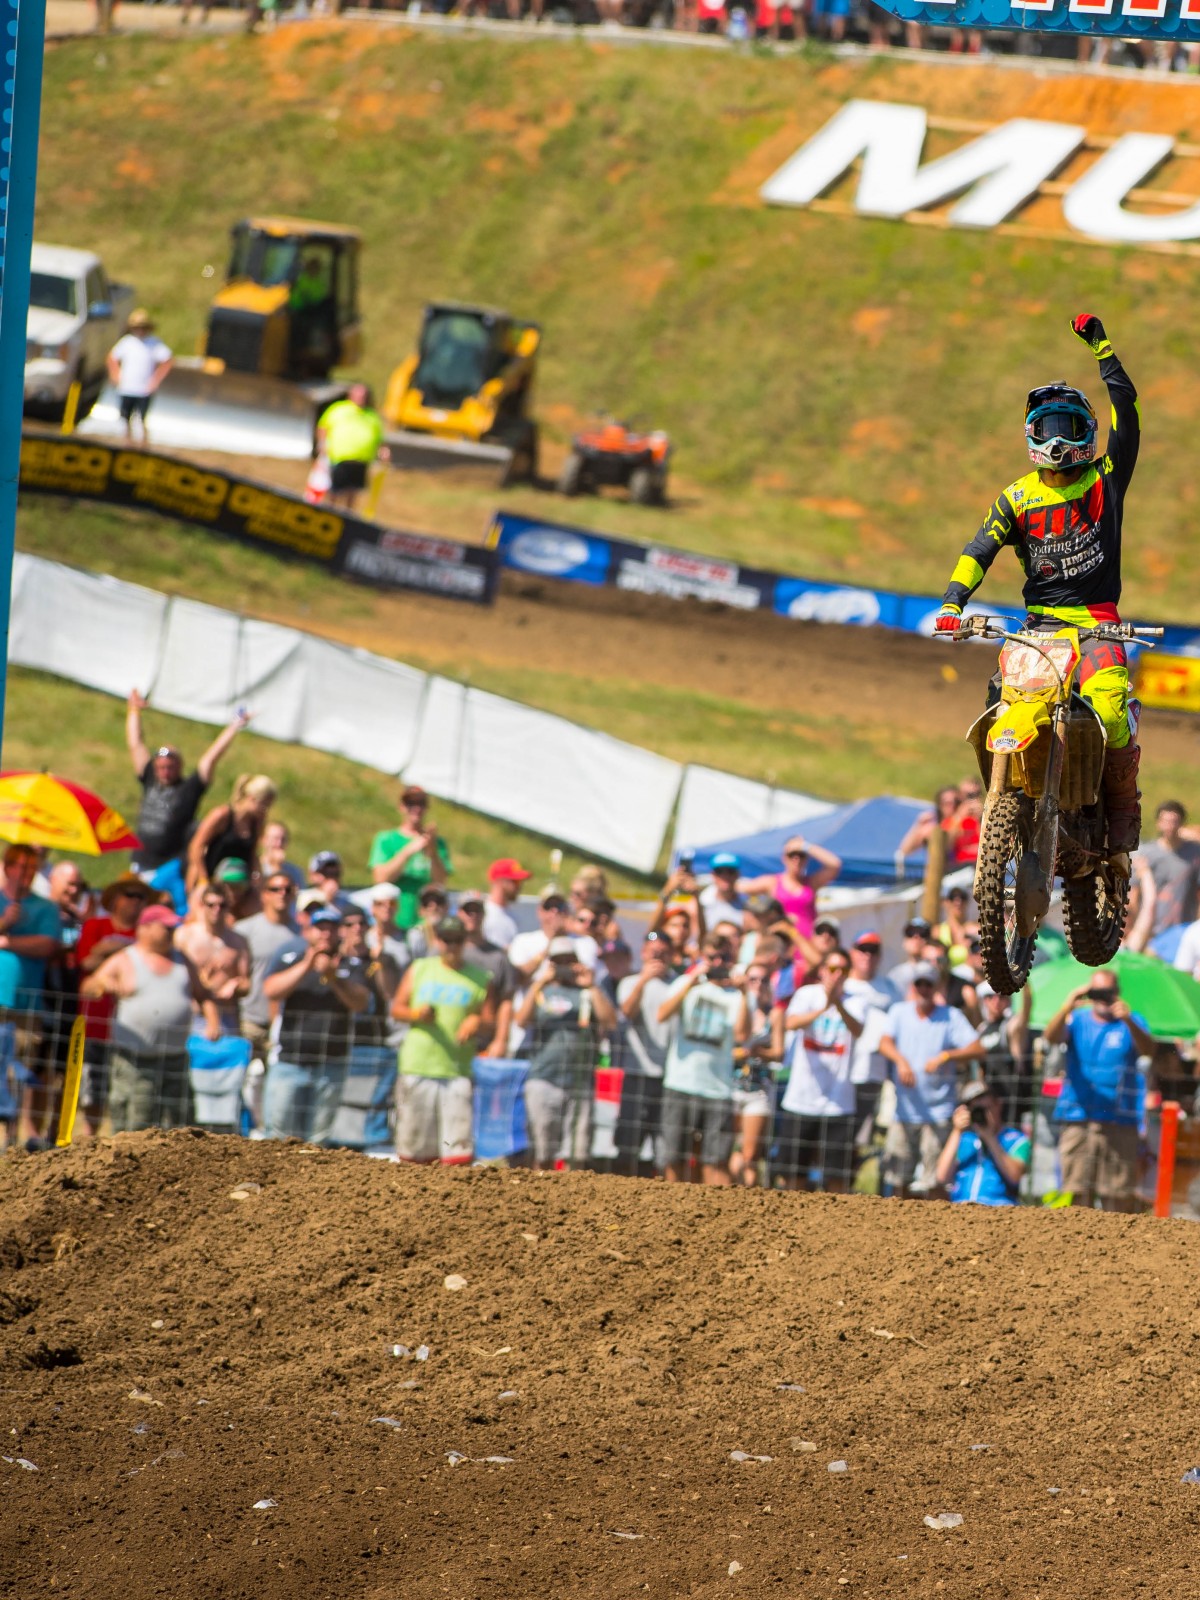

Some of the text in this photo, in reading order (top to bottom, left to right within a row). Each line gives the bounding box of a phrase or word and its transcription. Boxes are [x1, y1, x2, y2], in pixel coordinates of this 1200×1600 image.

[20, 440, 111, 475] EICO
[1071, 443, 1092, 463] Red
[1028, 540, 1072, 558] Soaring
[1060, 540, 1101, 569] JIMMY
[1062, 552, 1105, 580] JOHN'S
